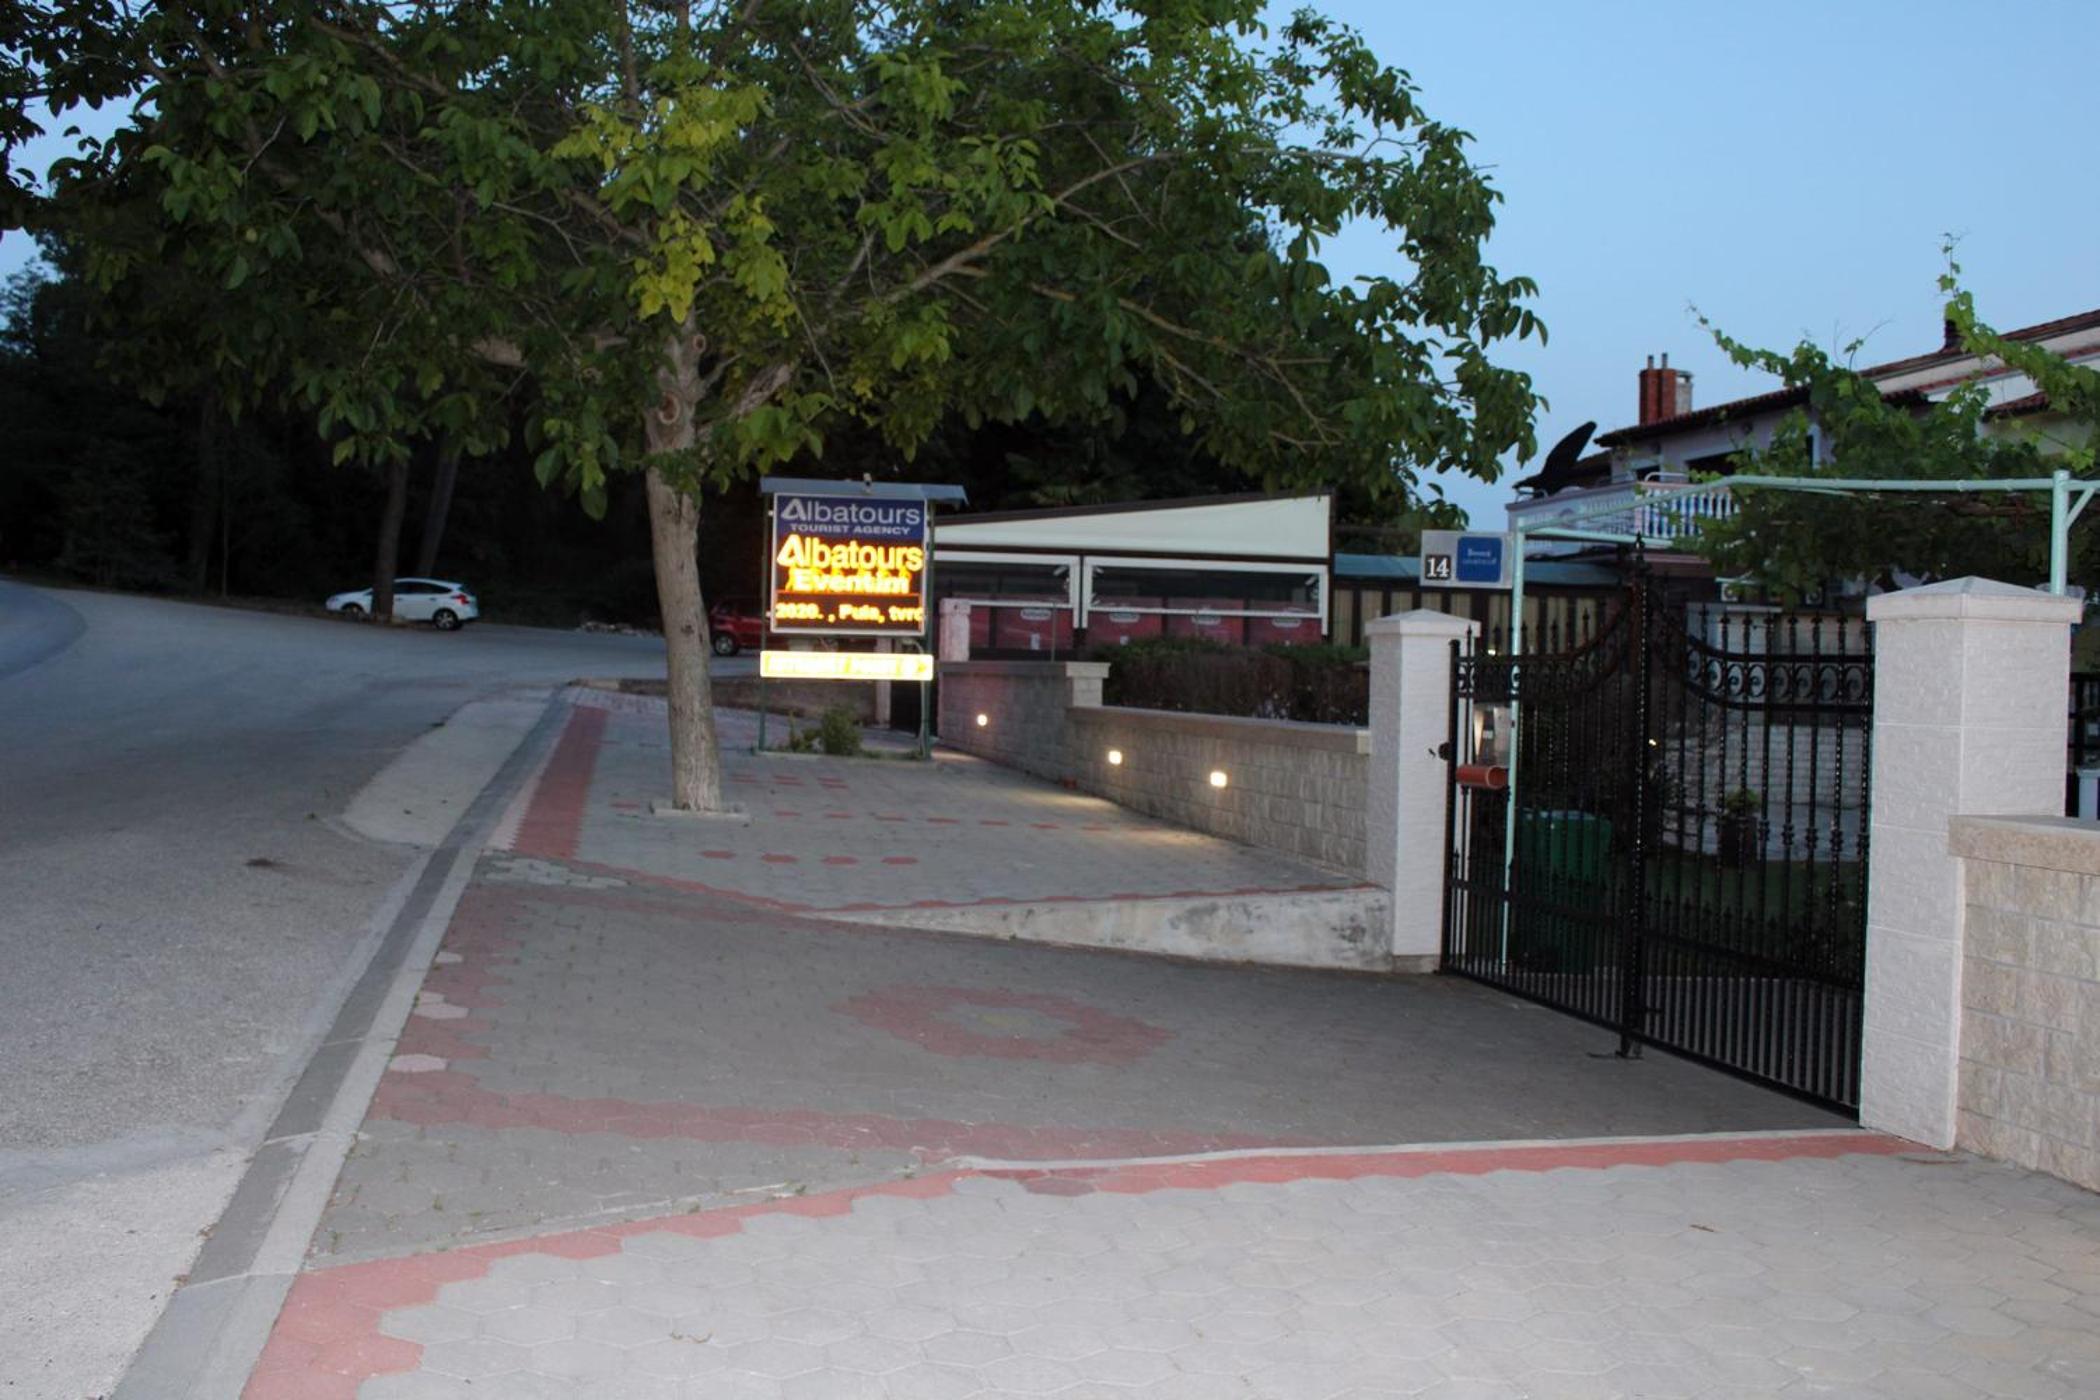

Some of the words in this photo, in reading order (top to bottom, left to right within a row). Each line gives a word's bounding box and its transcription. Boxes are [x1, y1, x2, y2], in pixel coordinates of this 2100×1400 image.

[781, 498, 921, 525] Albatours
[790, 523, 849, 533] TOURIST
[854, 525, 911, 535] AGENCY
[777, 534, 924, 571] Albatours
[1427, 557, 1449, 578] 14
[793, 570, 909, 594] Eventim
